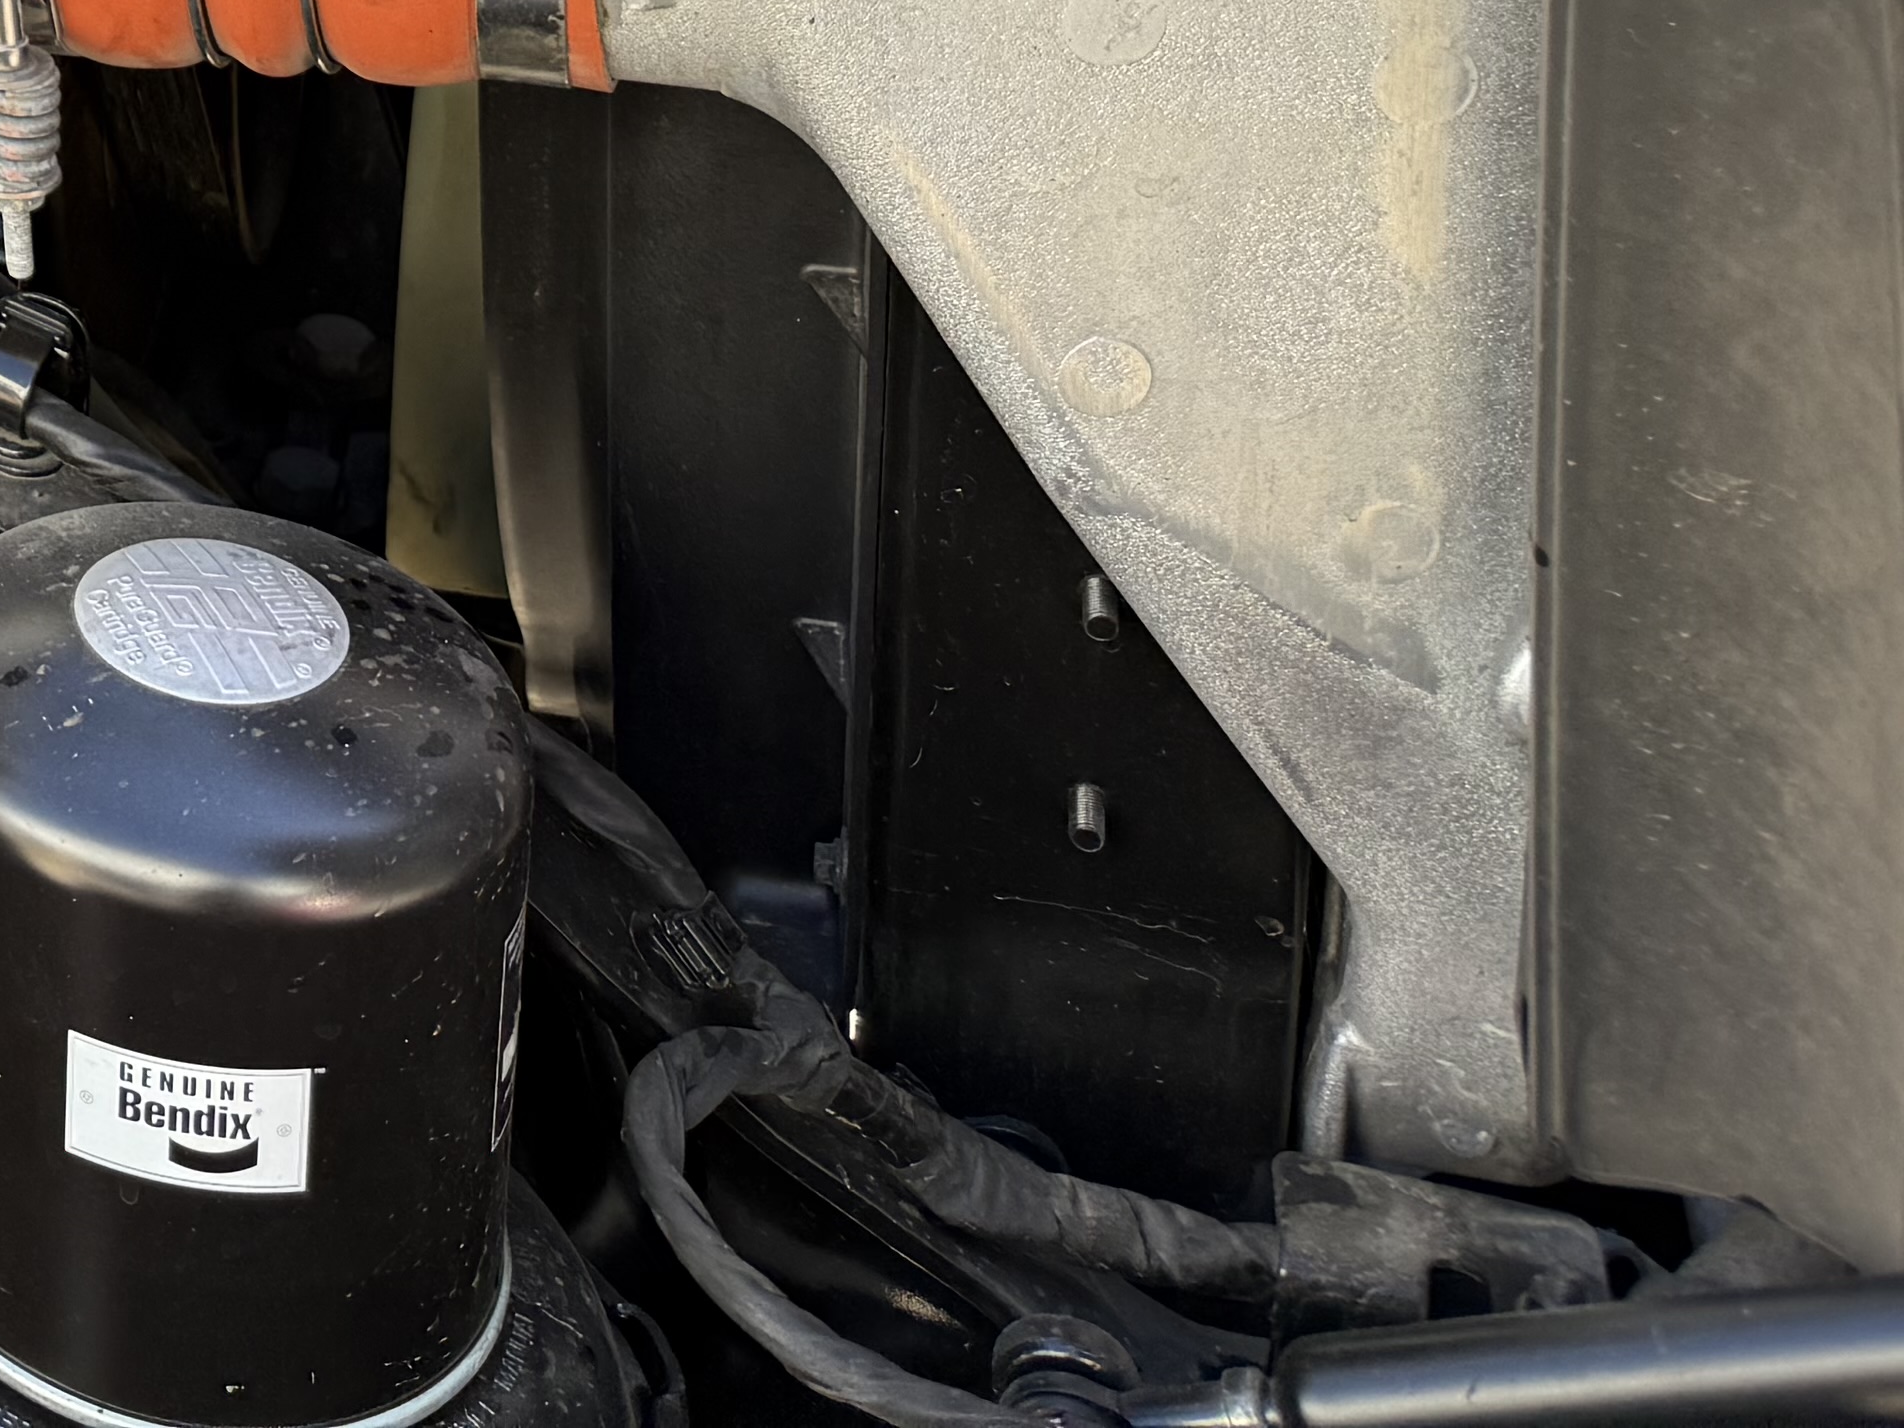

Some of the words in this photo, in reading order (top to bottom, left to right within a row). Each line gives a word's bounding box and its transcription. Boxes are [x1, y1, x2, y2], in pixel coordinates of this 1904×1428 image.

[86, 589, 147, 666] Cartridge
[119, 1060, 254, 1103] GENUINE
[118, 1085, 252, 1140] Bendix
